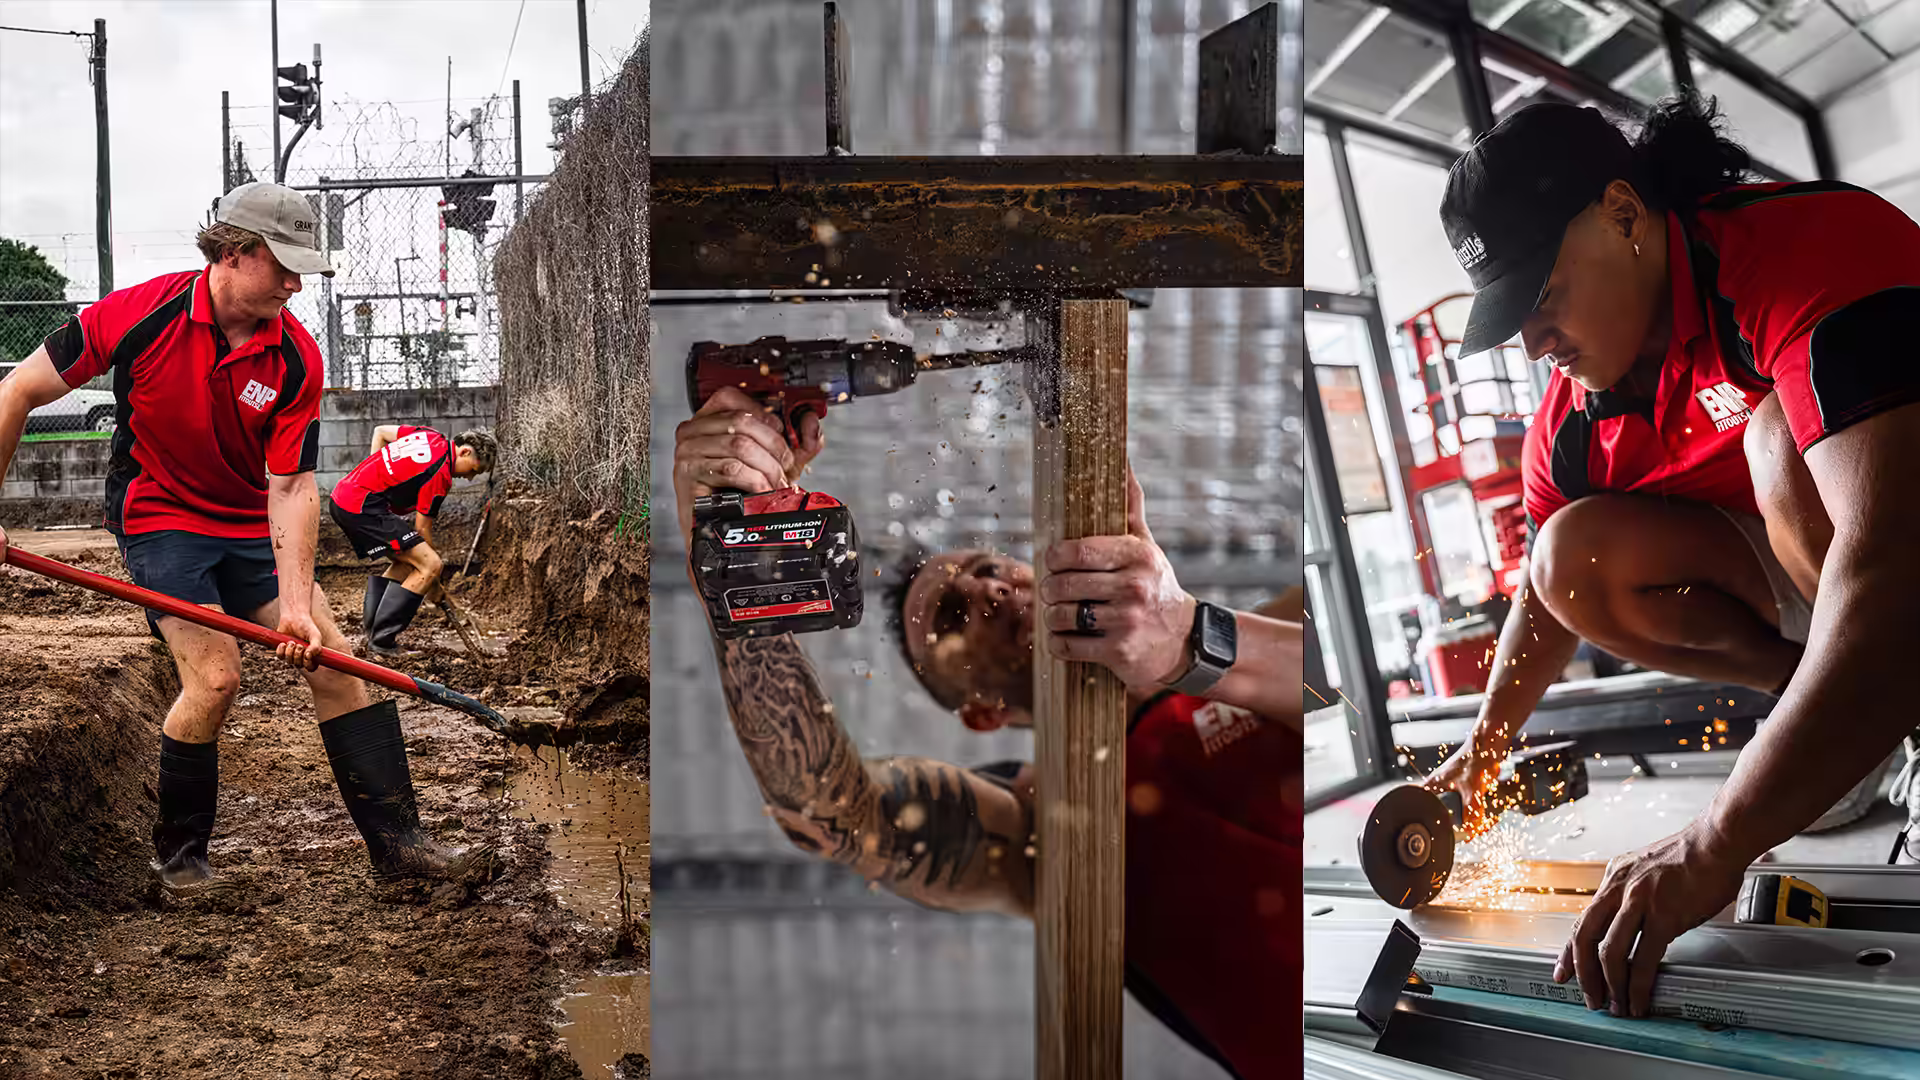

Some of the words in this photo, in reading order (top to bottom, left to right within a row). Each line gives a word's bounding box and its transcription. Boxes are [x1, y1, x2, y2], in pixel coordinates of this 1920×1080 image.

[241, 379, 277, 405] ENP
[1695, 382, 1749, 422] ENP
[1715, 411, 1748, 432] FITOUTS
[784, 529, 814, 539] M18
